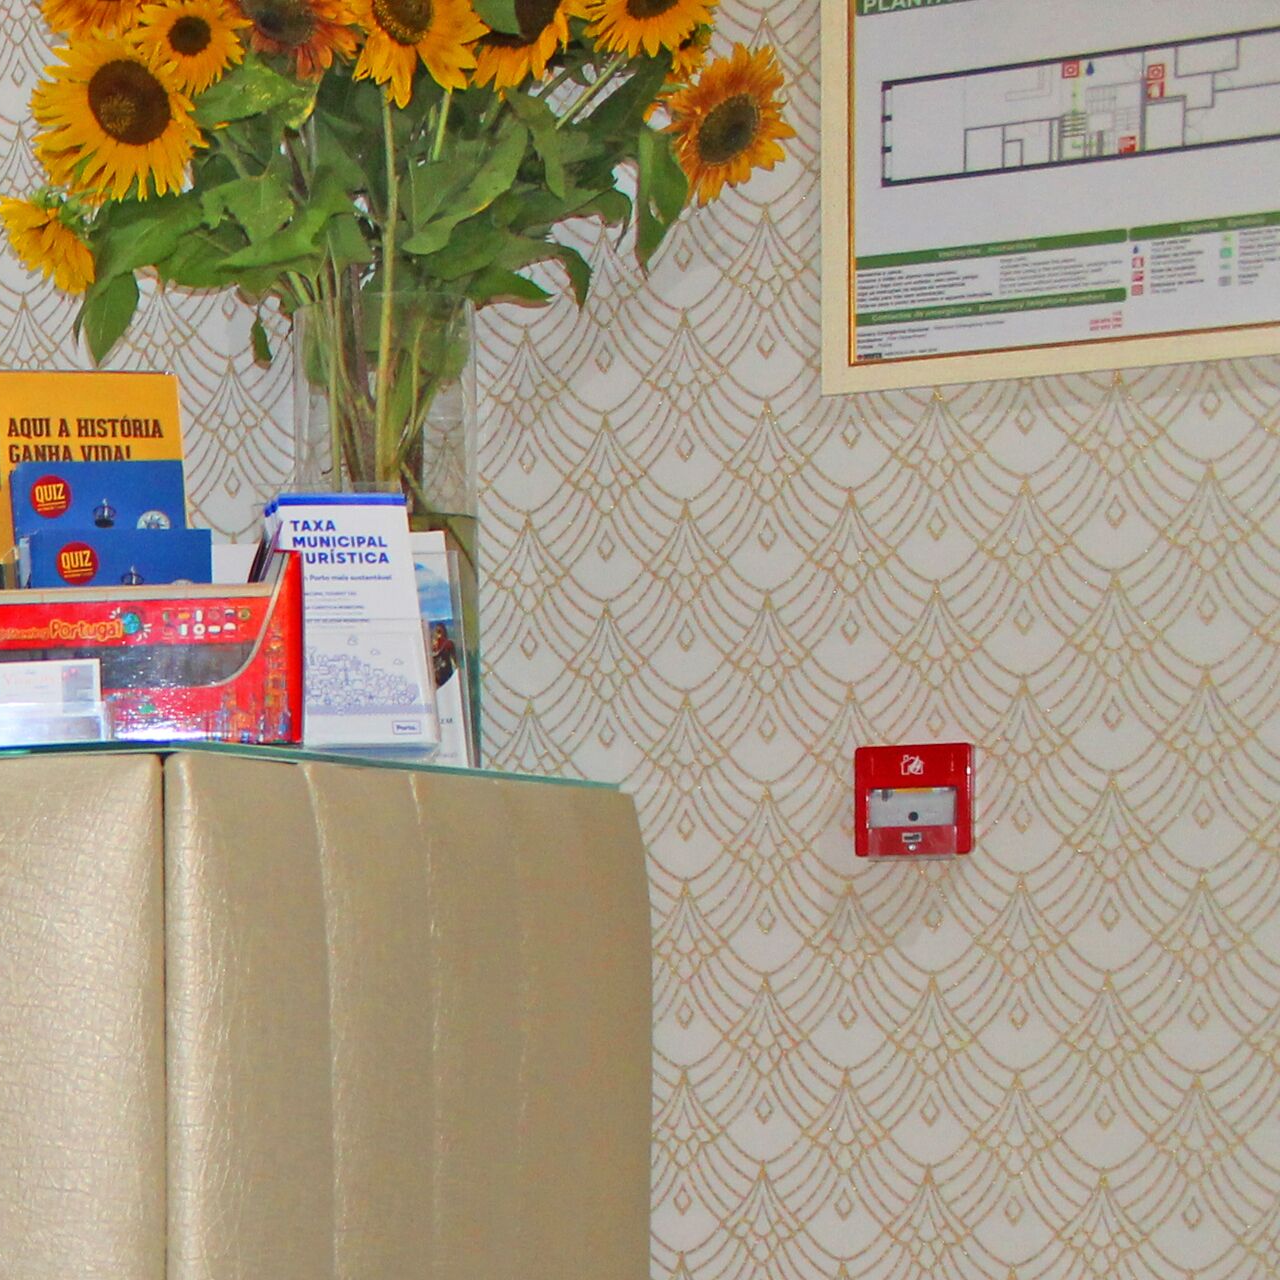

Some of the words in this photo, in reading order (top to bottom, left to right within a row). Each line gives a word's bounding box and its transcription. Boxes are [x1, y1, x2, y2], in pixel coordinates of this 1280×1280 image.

[7, 418, 51, 438] AQUI
[58, 418, 71, 438] A
[76, 414, 164, 438] HISTÓRIA
[9, 445, 73, 463] GANHA
[80, 445, 131, 462] VIDA!
[34, 483, 66, 504] QUIZ
[290, 520, 336, 532] TAXA
[292, 536, 388, 548] MUNICIPAL
[61, 549, 92, 570] QUIZ
[302, 549, 389, 565] URÍSTICA
[50, 618, 123, 642] Portugal
